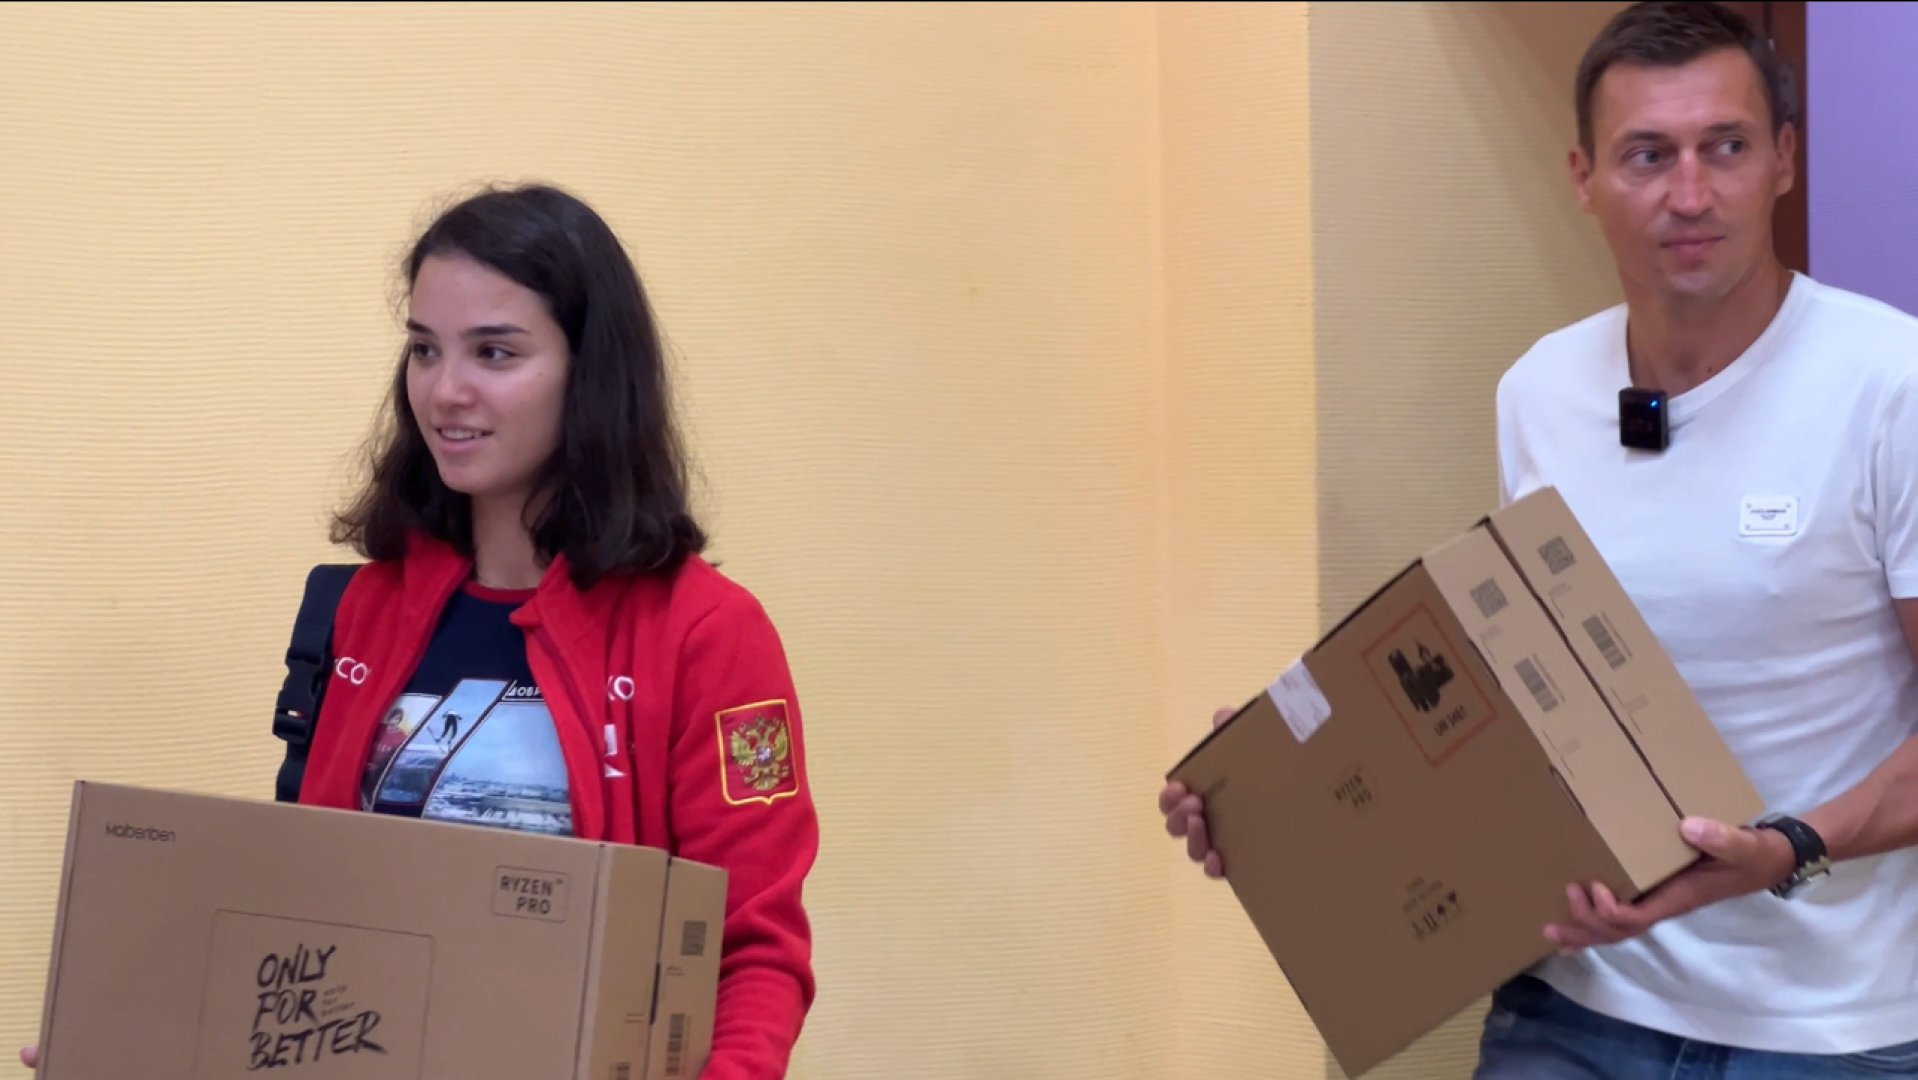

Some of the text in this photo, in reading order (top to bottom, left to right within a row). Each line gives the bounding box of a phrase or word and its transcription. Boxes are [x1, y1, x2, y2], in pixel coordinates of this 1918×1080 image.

[500, 875, 554, 896] RYZEN
[516, 896, 552, 915] PRO
[257, 943, 337, 988] ONLY
[252, 989, 320, 1031] FOR
[247, 1010, 388, 1071] BETTER
